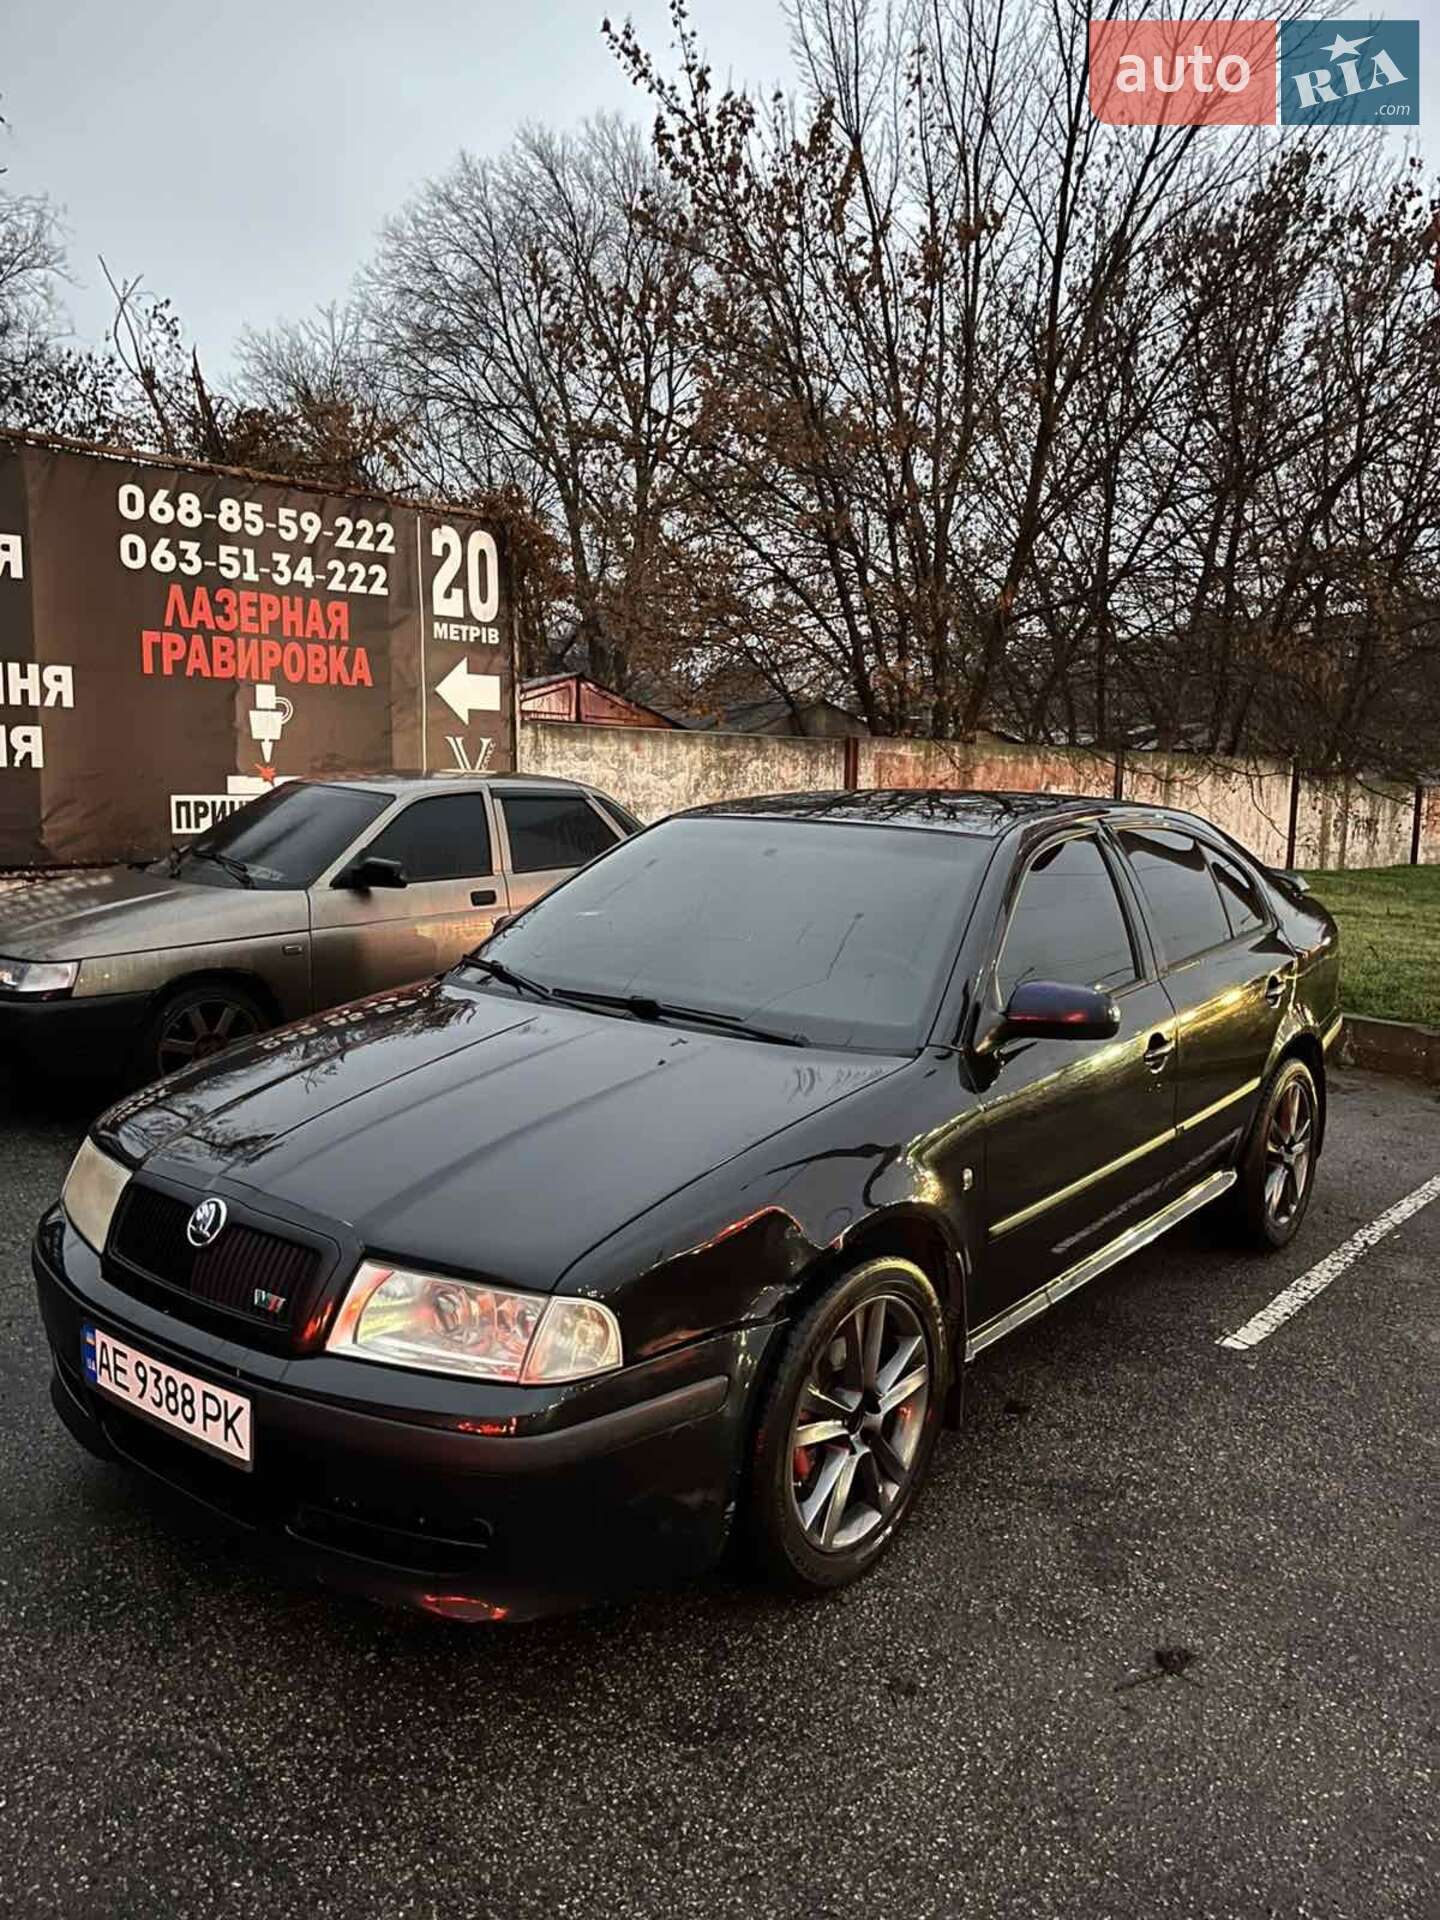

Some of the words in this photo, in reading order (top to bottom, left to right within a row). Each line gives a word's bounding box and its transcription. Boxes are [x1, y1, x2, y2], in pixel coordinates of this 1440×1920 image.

[118, 483, 396, 554] 068-85-59-222
[119, 533, 389, 596] 063-51-34-222
[432, 525, 499, 622] 20
[164, 583, 349, 641] ЛАЗЕРНАЯ
[433, 622, 500, 644] МЕТРІВ
[0, 662, 74, 708] НЯ
[141, 630, 374, 687] ГРАВИРОВКА
[0, 725, 44, 768] Я
[99, 1341, 131, 1393] AE
[135, 1360, 196, 1425] 9388
[202, 1390, 245, 1450] PK
